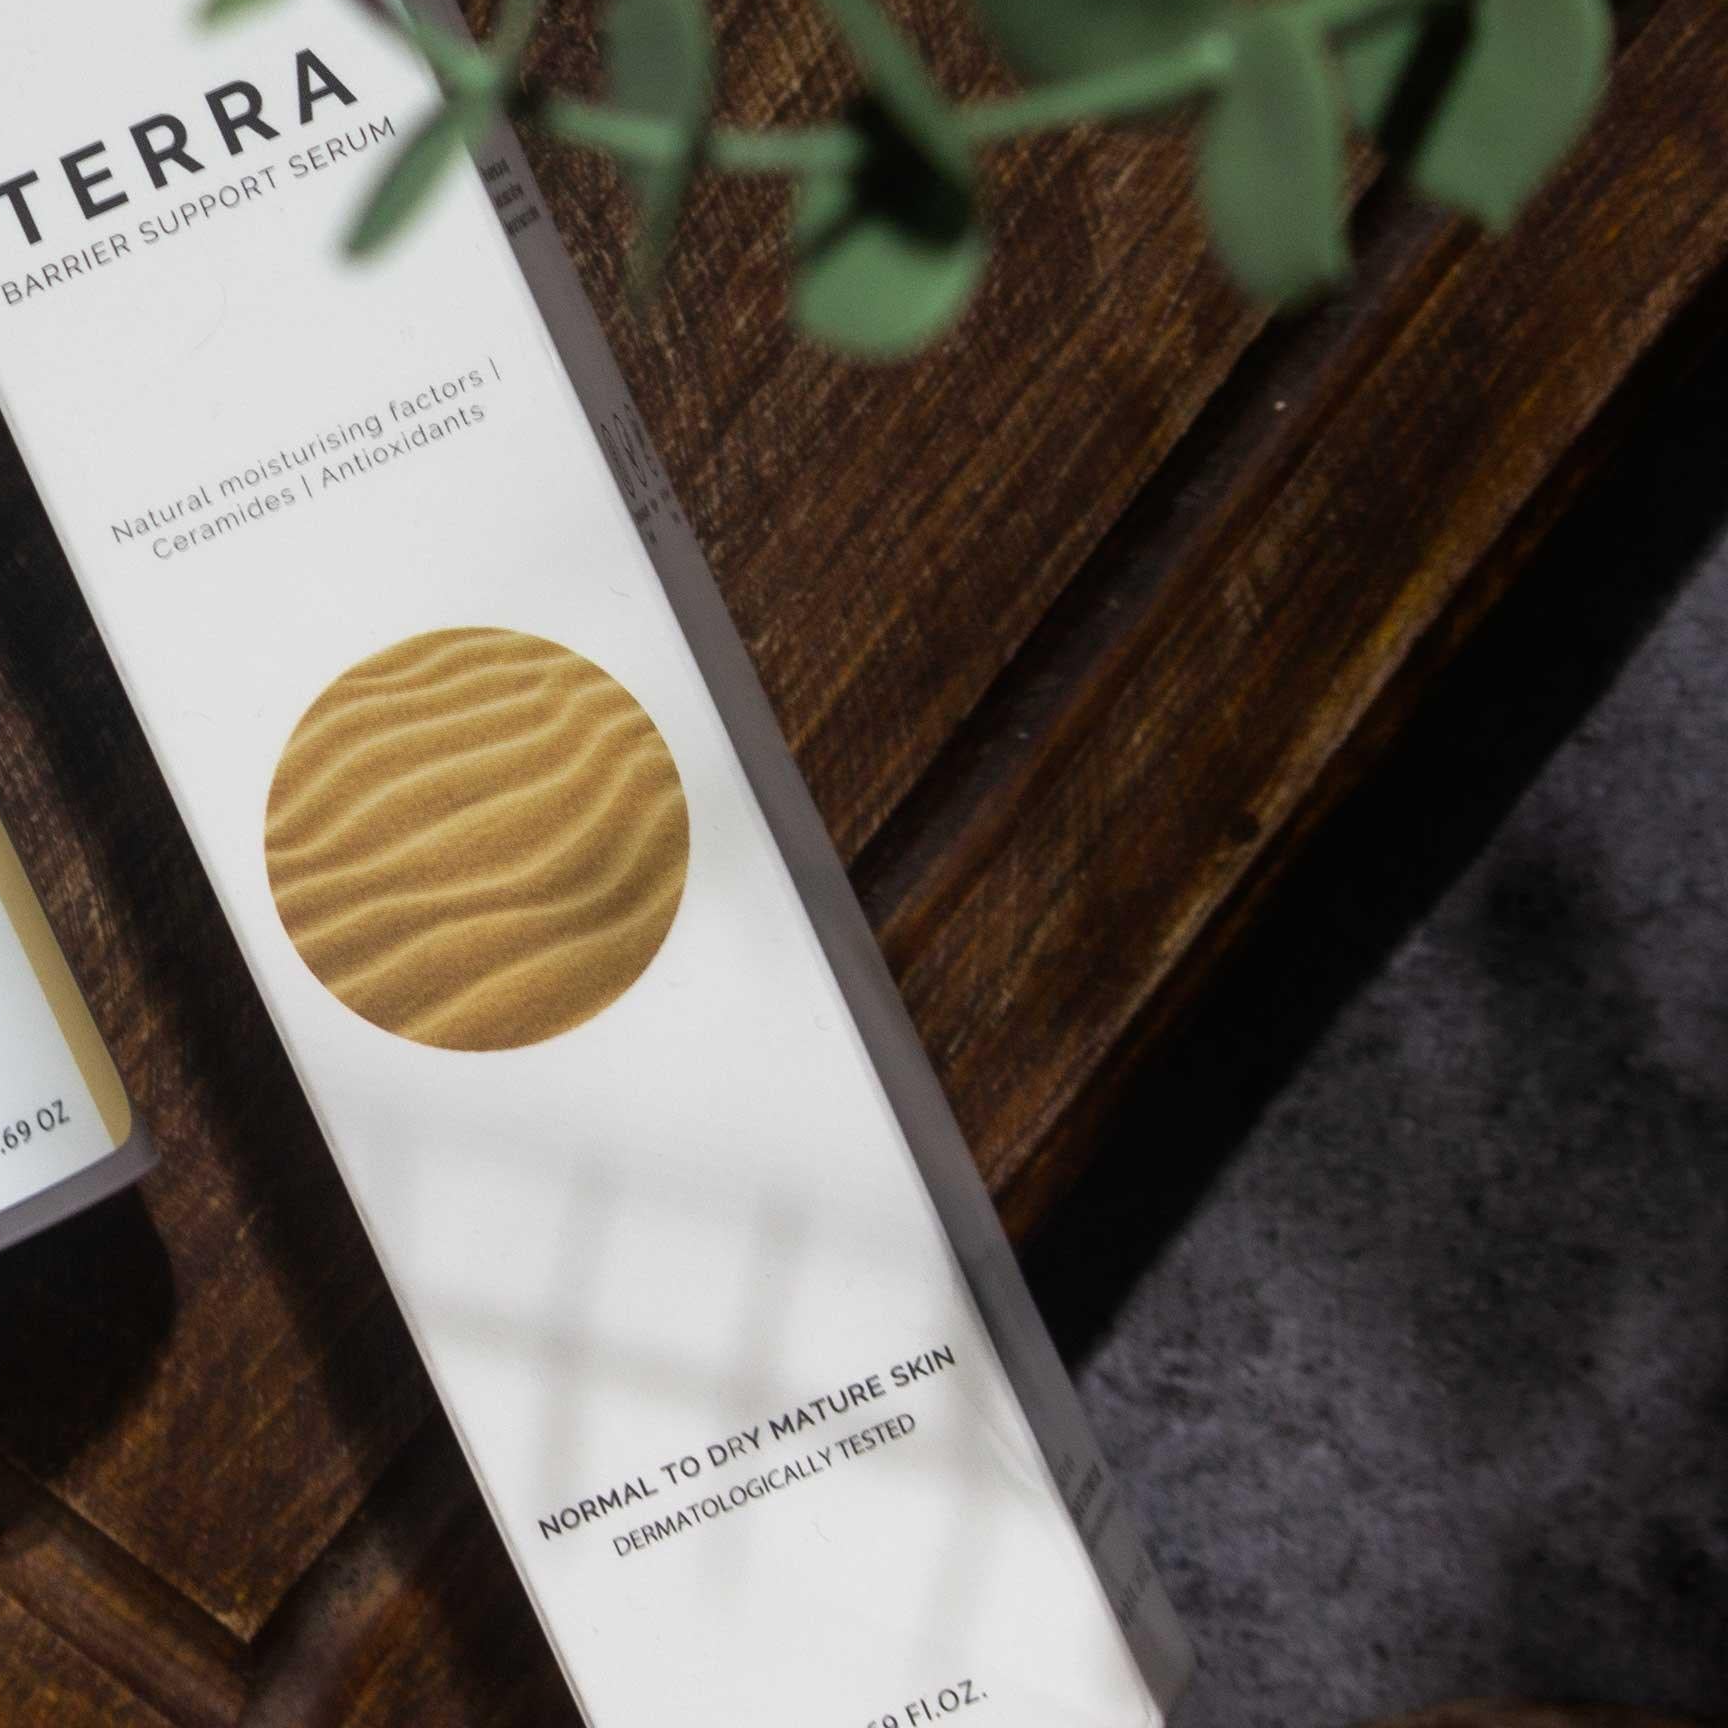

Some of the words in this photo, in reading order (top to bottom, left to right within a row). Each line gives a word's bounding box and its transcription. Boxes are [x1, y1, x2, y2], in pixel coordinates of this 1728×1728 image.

[0, 232, 132, 306] BARRIER
[137, 165, 277, 246] SUPPORT
[287, 115, 397, 179] SERUM
[110, 484, 215, 544] Natural
[219, 415, 385, 493] moisturising
[389, 365, 486, 423] factors
[152, 486, 297, 561] Ceramides
[320, 401, 486, 490] Antioxidants
[36, 1098, 71, 1133] OZ
[537, 1474, 658, 1541] NORMAL
[660, 1454, 701, 1488] TO
[706, 1427, 764, 1468] DRY
[769, 1374, 886, 1443] MATURE
[890, 1344, 956, 1390] SKIN
[612, 1446, 835, 1557] DERMATOLOGICALLY
[834, 1412, 917, 1463] TESTED
